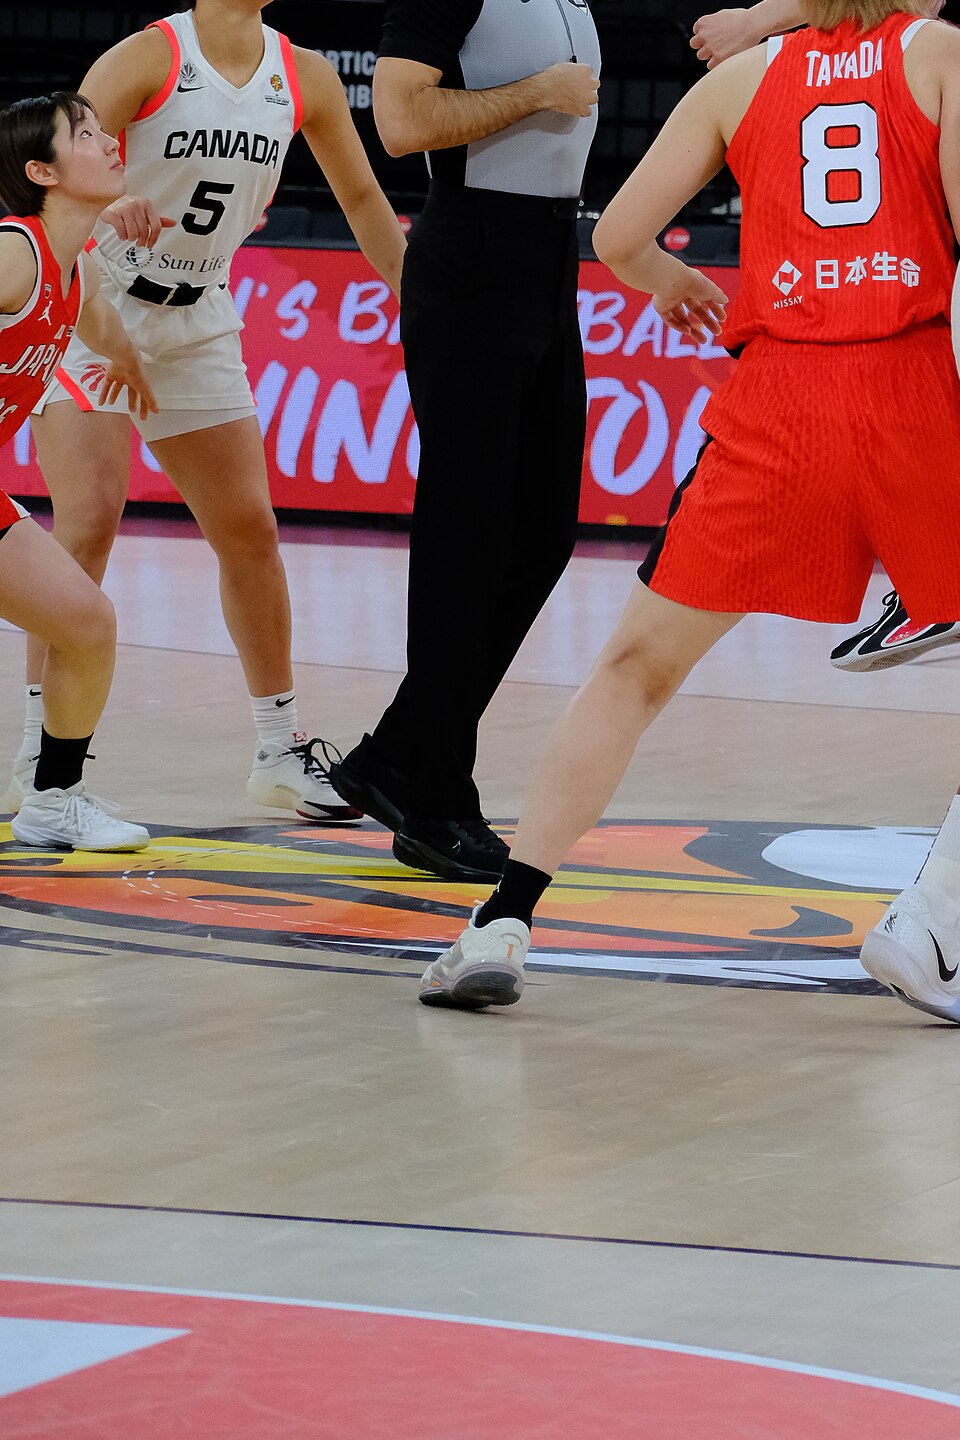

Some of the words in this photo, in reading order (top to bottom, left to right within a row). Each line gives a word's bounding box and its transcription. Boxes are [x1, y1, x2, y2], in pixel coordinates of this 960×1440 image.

[806, 37, 883, 87] TAKADA
[164, 129, 279, 170] CANADA
[800, 101, 882, 228] 8
[181, 180, 235, 236] 5
[158, 253, 195, 271] Sun
[815, 251, 921, 289] 日本生命
[773, 295, 803, 310] NISSAY
